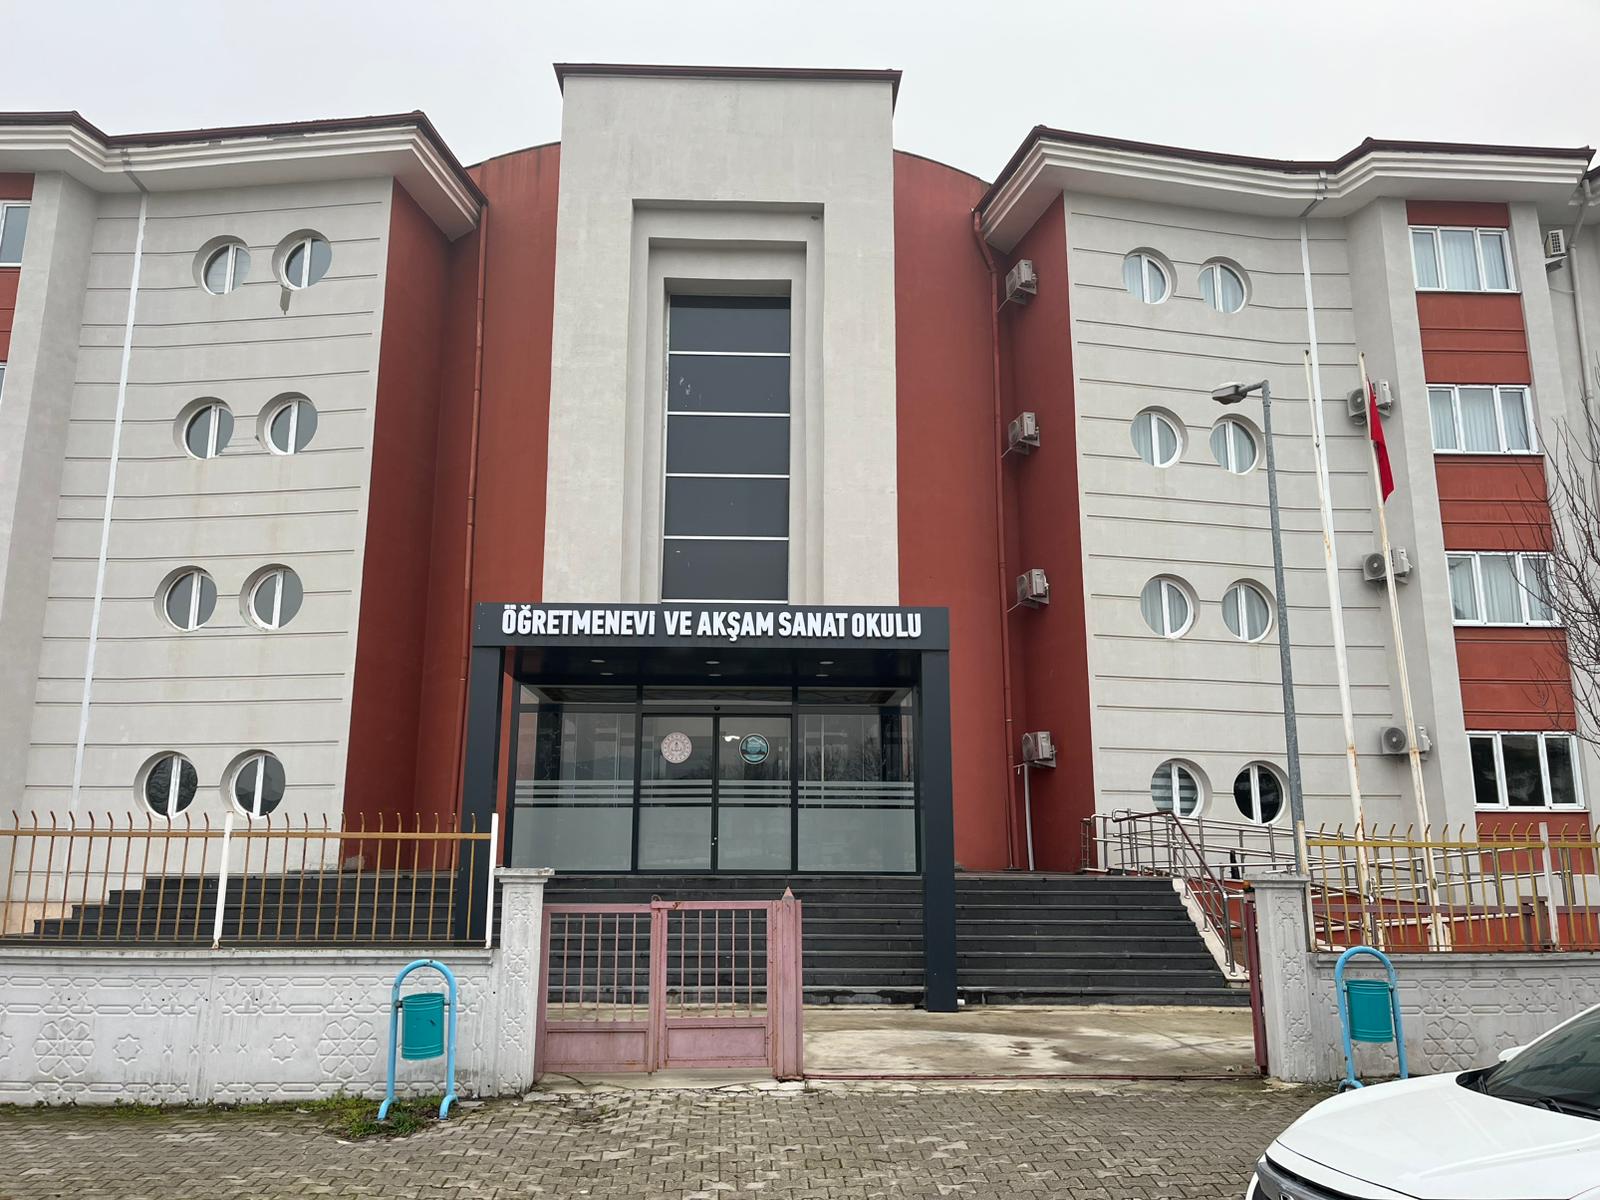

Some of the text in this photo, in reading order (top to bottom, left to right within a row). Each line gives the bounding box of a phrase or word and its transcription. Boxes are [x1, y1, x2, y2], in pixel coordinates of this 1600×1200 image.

[501, 604, 922, 642] ÖĞRETMENEVİ VE AKŞAM SANAT OKULU
